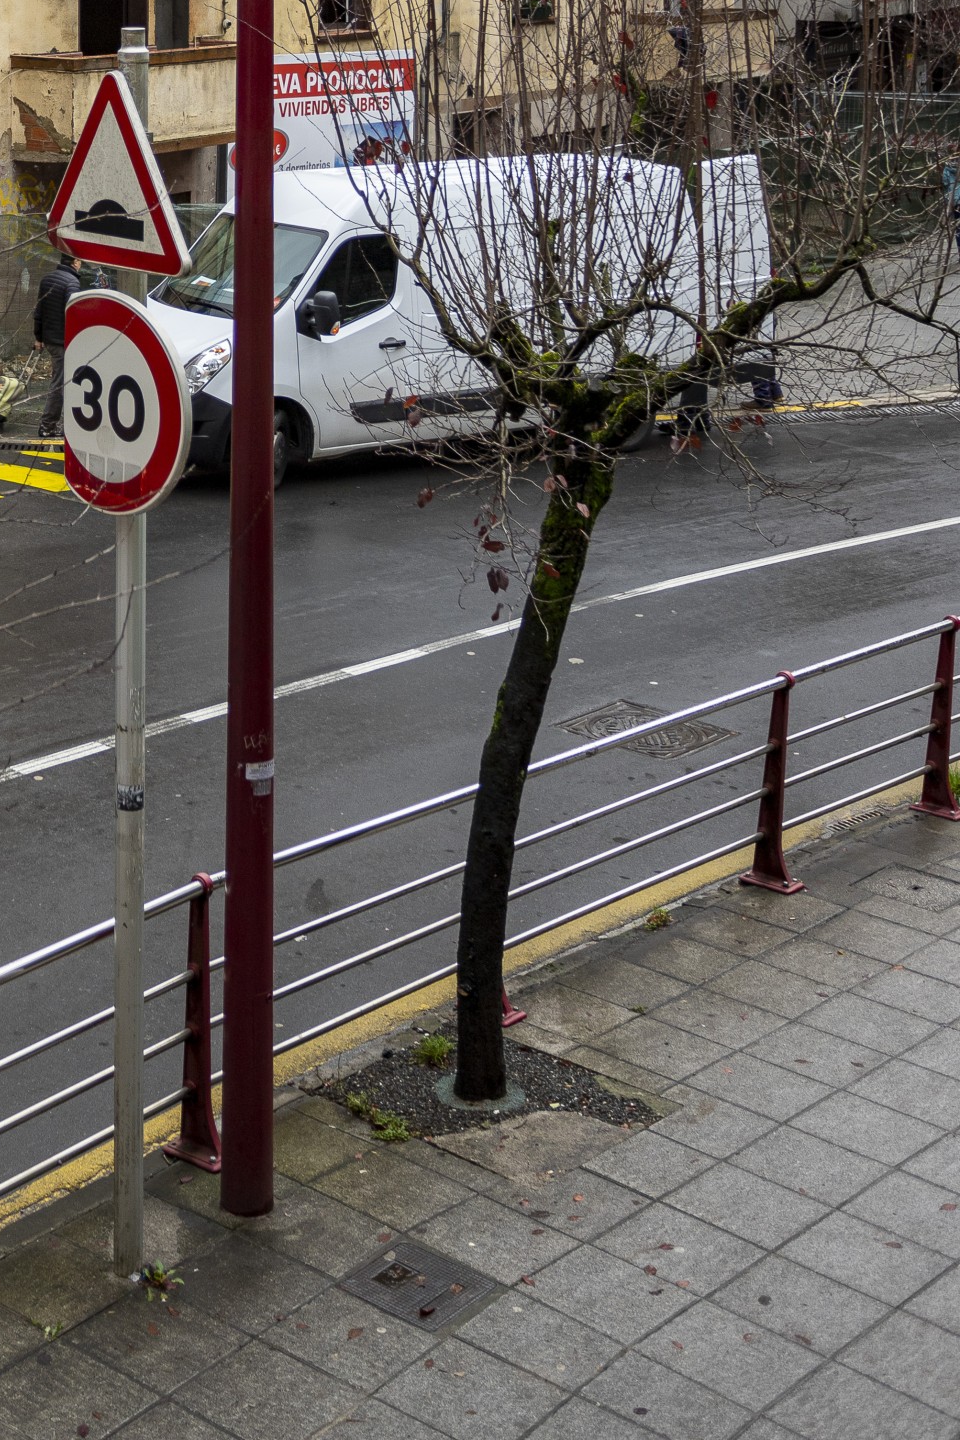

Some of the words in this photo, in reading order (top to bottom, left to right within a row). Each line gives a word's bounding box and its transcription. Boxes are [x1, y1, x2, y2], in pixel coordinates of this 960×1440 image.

[274, 72, 302, 95] EVA
[279, 99, 346, 117] VIVIENDAS
[72, 364, 146, 442] 30
